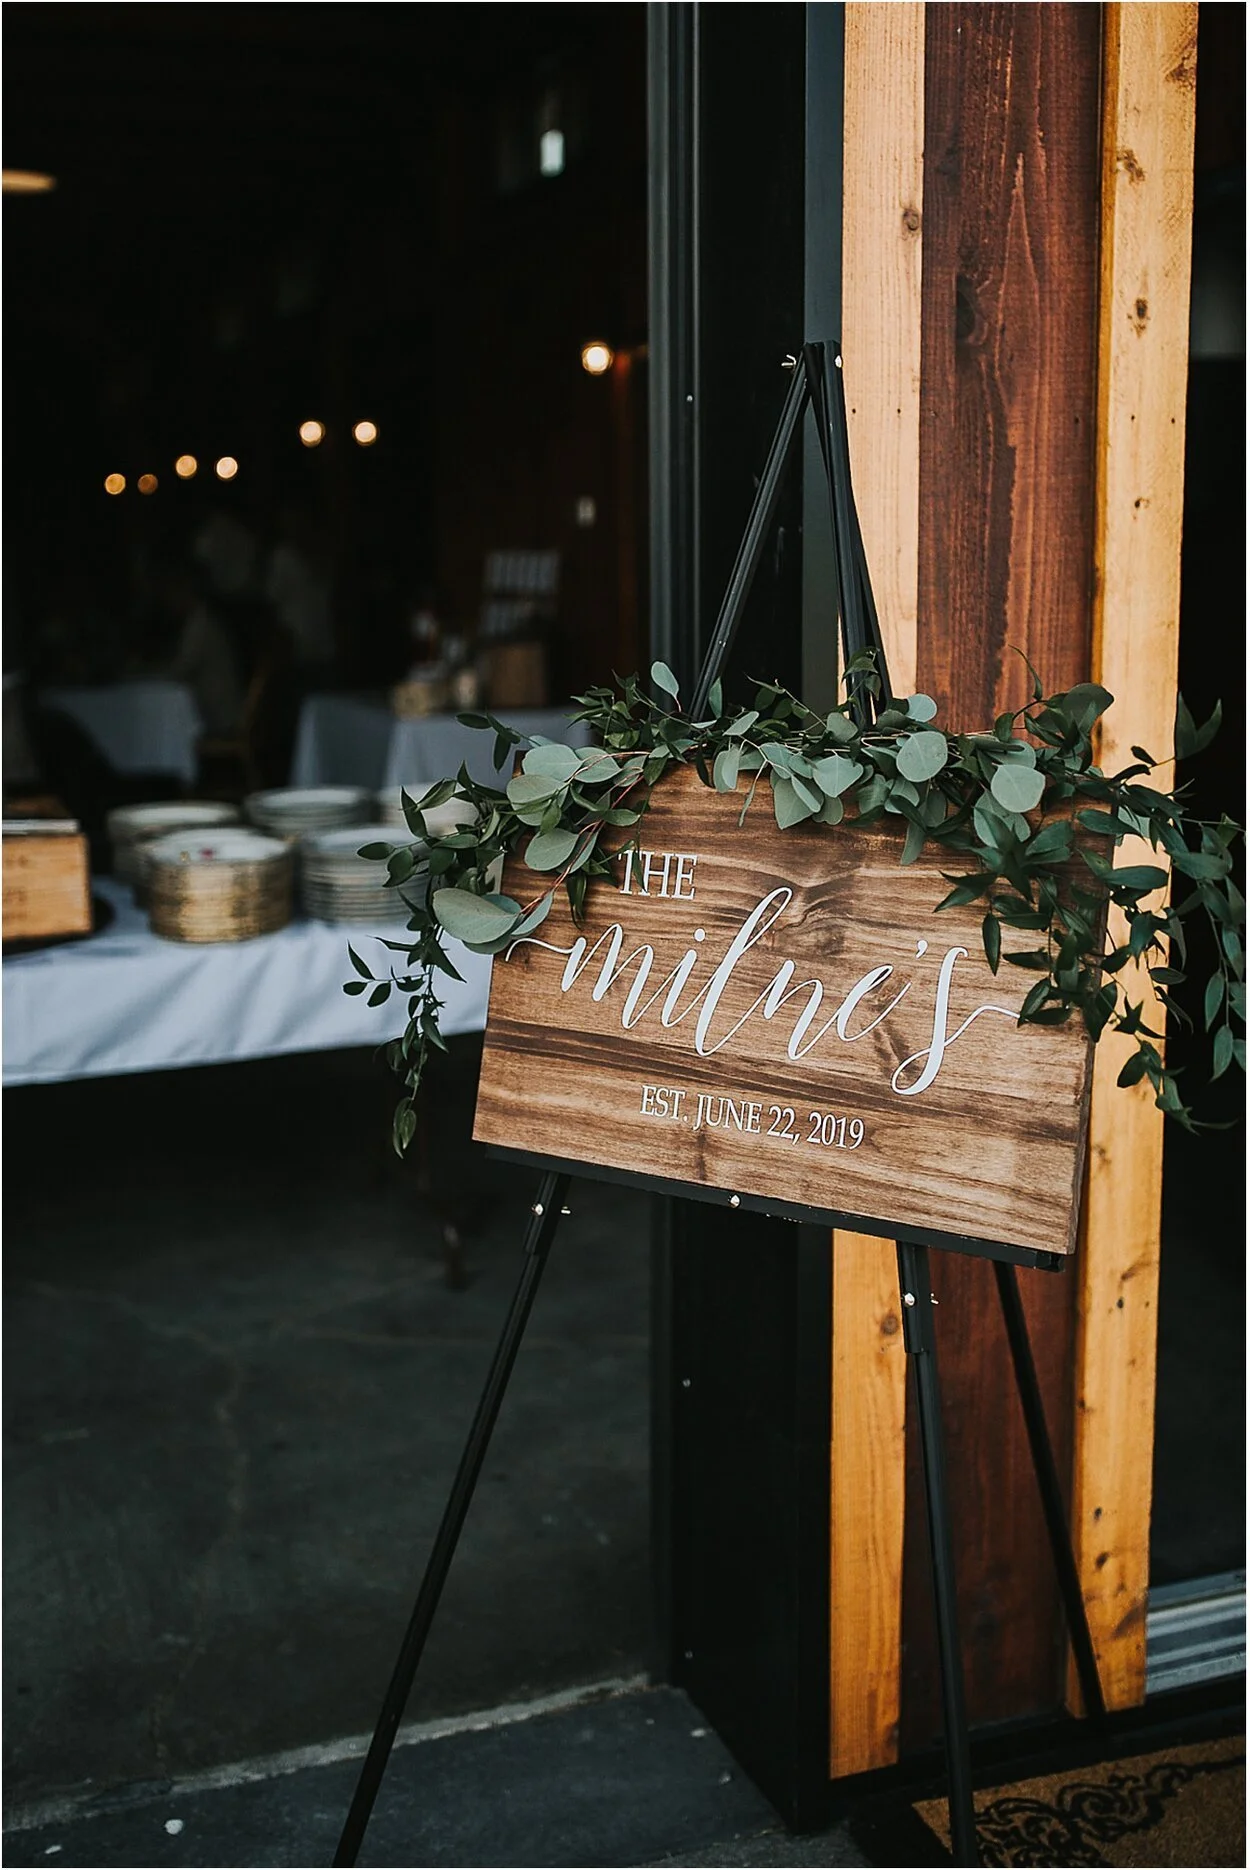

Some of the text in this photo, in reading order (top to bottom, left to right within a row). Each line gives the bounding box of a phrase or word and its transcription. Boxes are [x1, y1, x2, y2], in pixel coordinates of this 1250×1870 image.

[617, 849, 698, 900] THE
[505, 886, 1022, 1096] milne's
[640, 1085, 865, 1150] EST. JUNE 22, 2019
